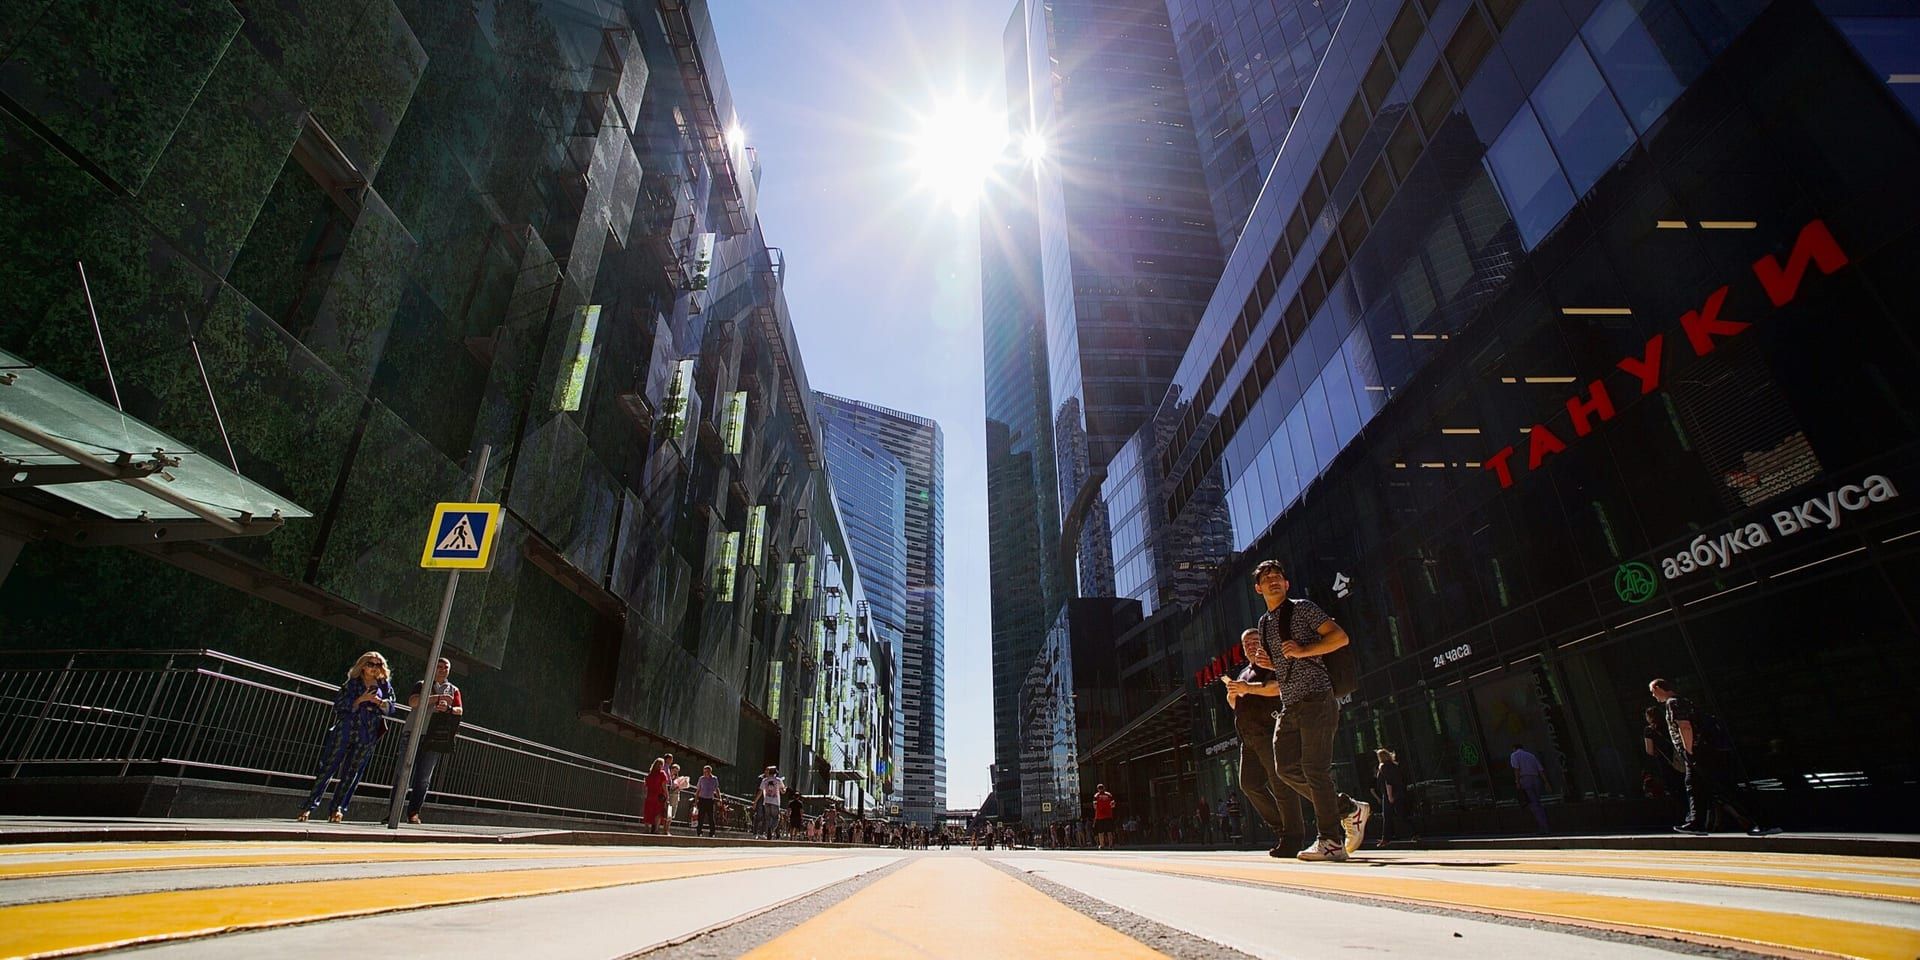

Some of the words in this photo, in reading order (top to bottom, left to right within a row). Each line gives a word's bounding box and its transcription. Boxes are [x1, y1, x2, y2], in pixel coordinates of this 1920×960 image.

[1485, 222, 1848, 489] ТАНУКИ
[1661, 521, 1772, 580] азбука
[1770, 473, 1899, 538] вкуса
[1432, 655, 1447, 669] 24
[1444, 643, 1473, 662] часа
